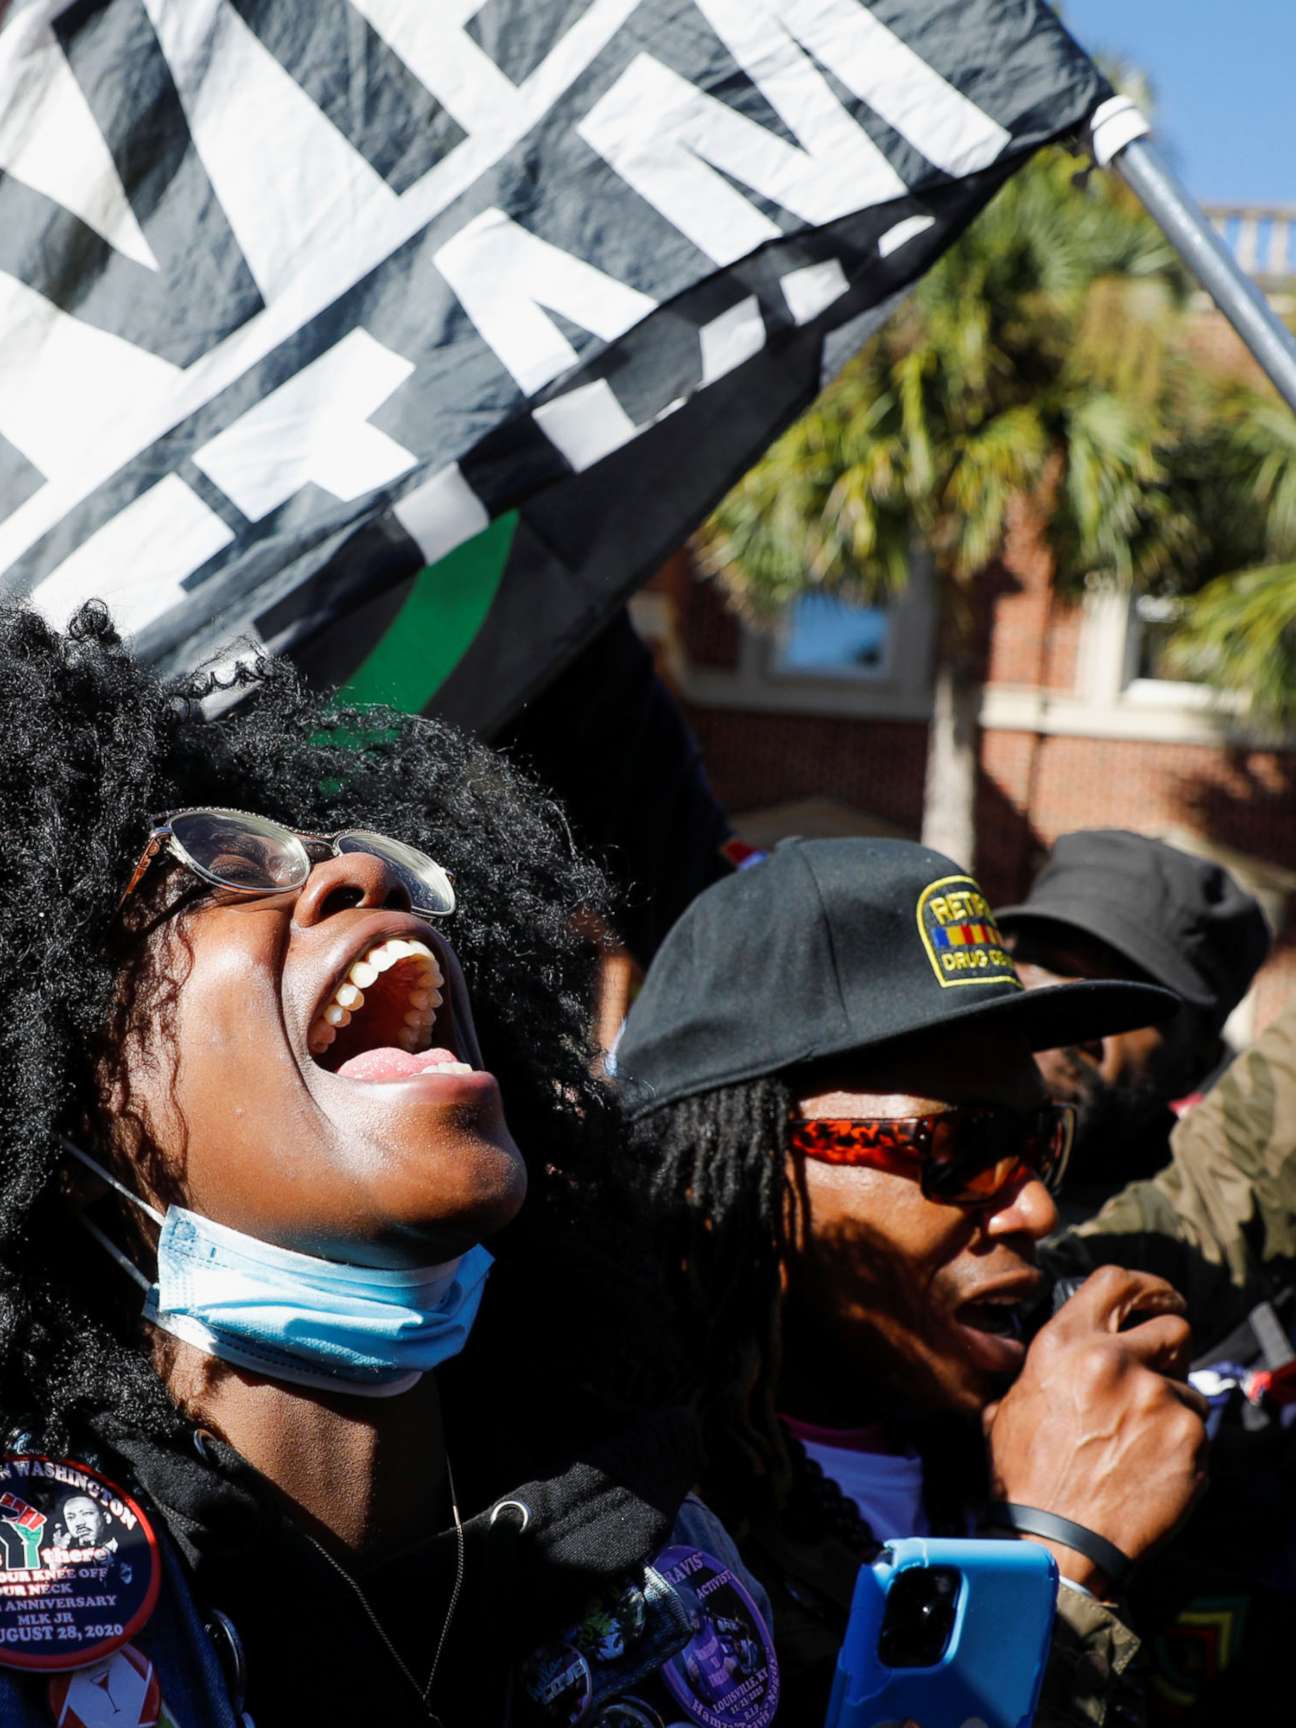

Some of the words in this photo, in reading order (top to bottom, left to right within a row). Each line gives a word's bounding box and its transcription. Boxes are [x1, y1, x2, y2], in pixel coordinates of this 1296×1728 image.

[941, 949, 988, 971] DRUG
[13, 1460, 137, 1531] WASHINGTON
[33, 1568, 77, 1582] KNEE
[79, 1568, 109, 1579] OFF
[28, 1583, 73, 1596] NECK
[5, 1595, 117, 1612] ANNIVERSARY
[17, 1613, 50, 1626] MLK
[54, 1612, 75, 1623] JR
[57, 1625, 83, 1641] 28,
[85, 1624, 124, 1637] 2020
